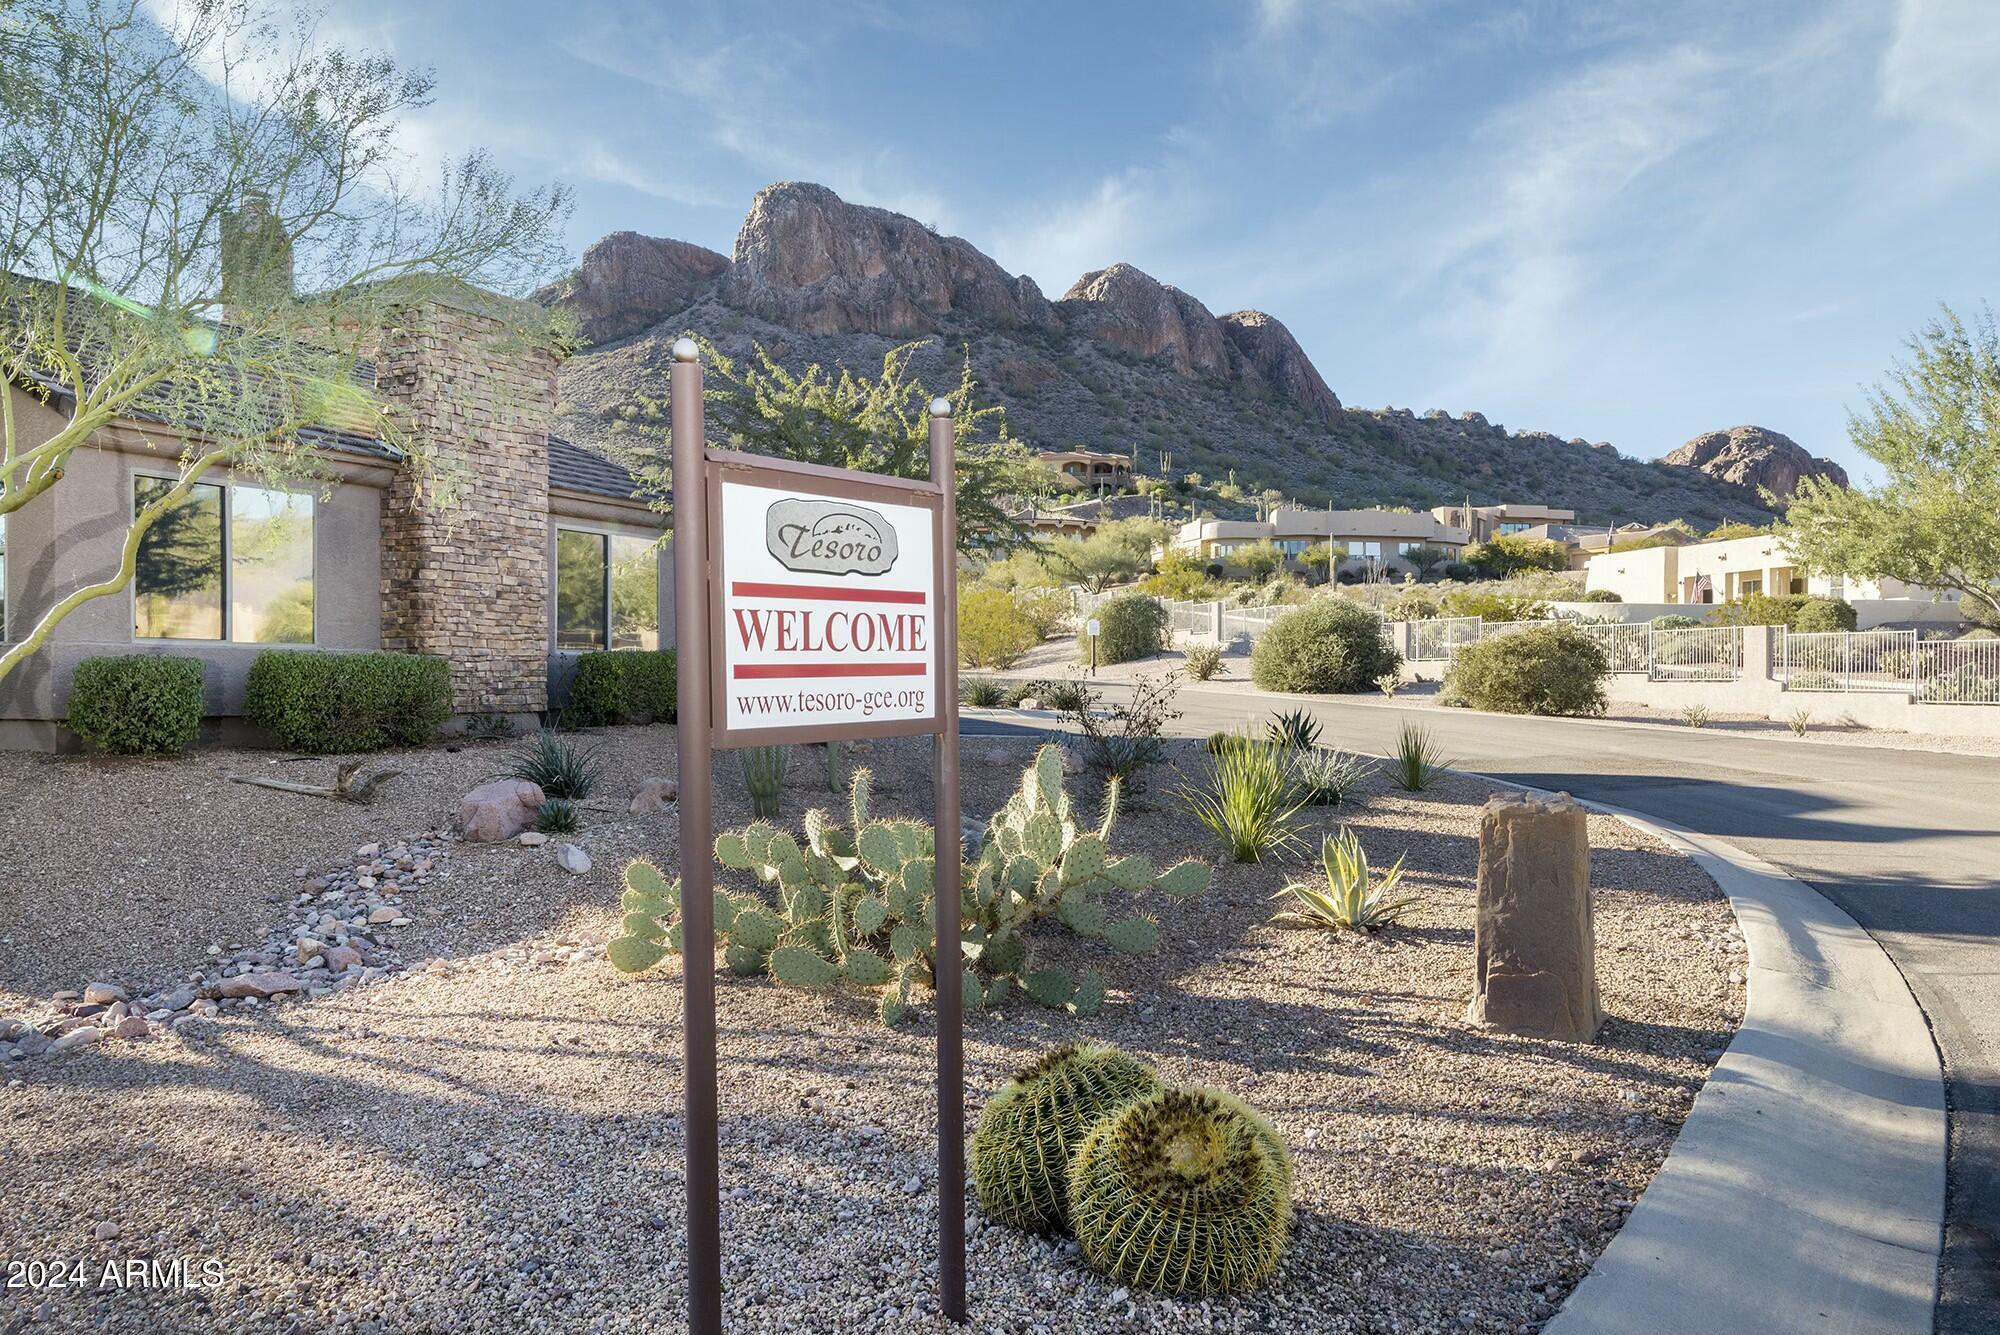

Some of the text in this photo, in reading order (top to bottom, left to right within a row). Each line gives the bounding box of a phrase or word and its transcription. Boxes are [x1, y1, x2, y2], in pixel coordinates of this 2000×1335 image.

[778, 523, 882, 562] Tesoro
[733, 608, 927, 652] WELCOME
[737, 689, 925, 716] www.tesoro-gce.org
